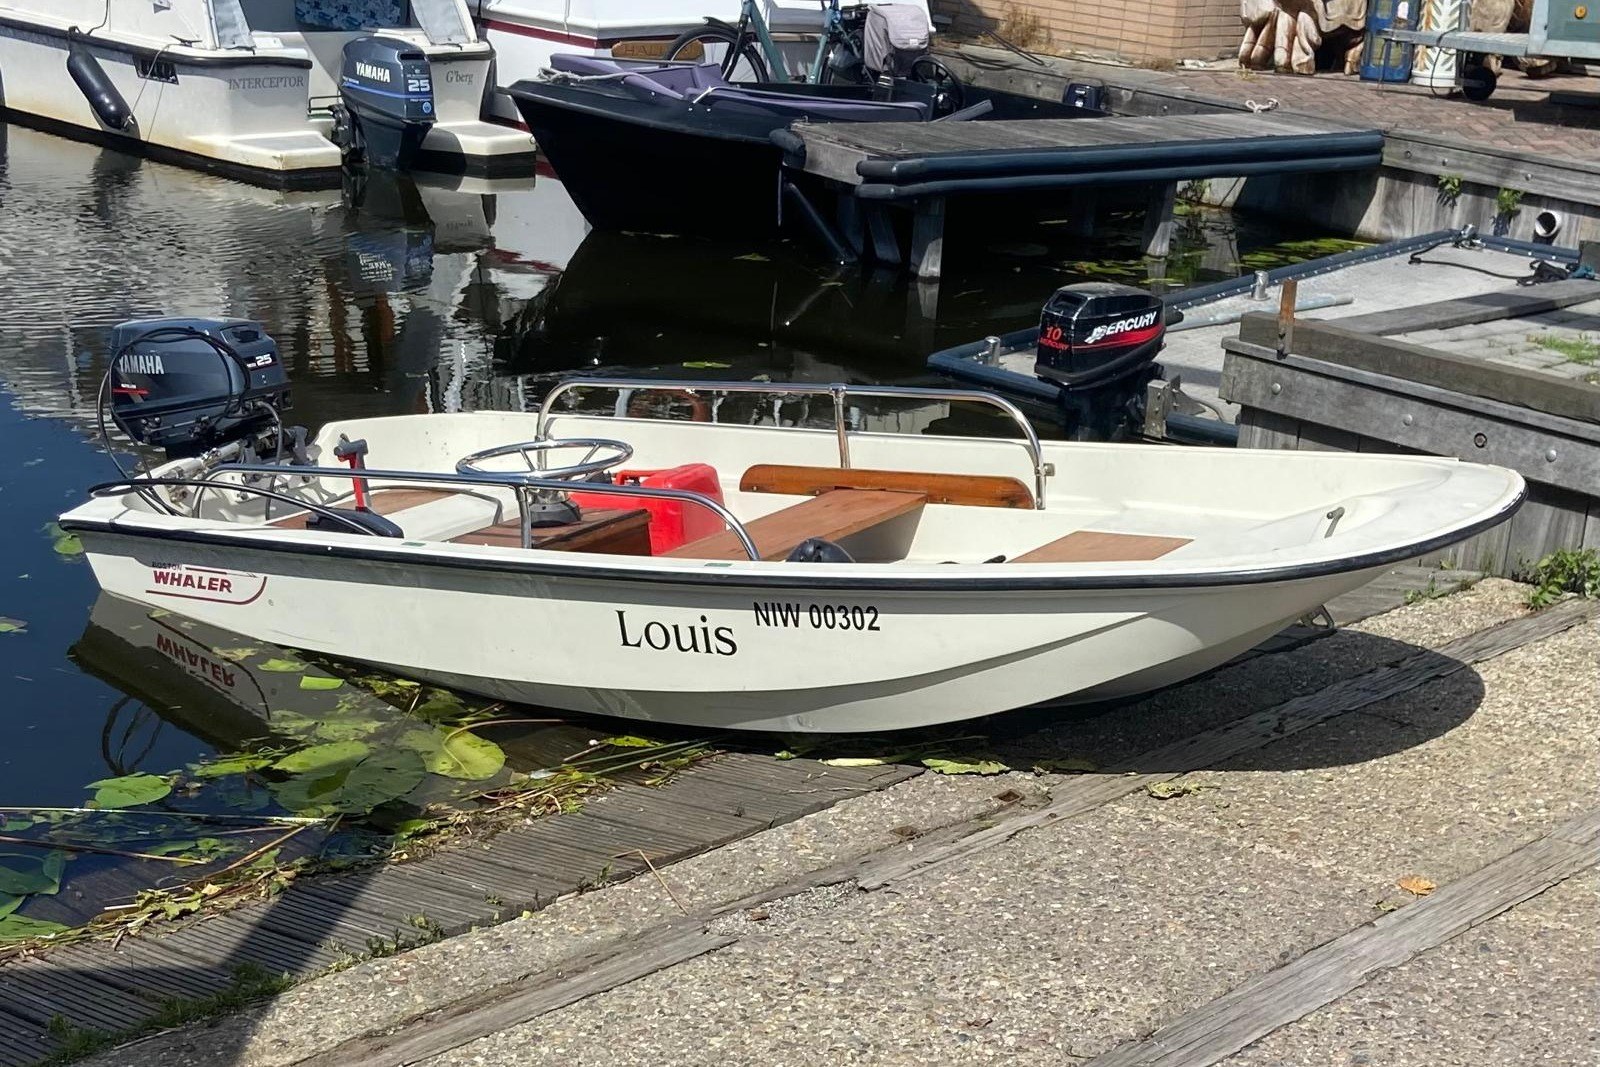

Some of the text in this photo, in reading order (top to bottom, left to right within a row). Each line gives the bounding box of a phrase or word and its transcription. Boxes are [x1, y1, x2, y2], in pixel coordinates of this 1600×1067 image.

[356, 62, 391, 82] YAMAHA
[228, 76, 304, 90] INTERCEPTOR
[408, 79, 431, 92] 25
[1046, 326, 1062, 340] 10
[119, 354, 165, 375] YAMAHA
[255, 353, 272, 366] 25
[152, 561, 182, 573] BOSTON
[153, 570, 233, 593] WHALER
[753, 602, 881, 631] NIW 00302
[615, 609, 738, 656] Louis
